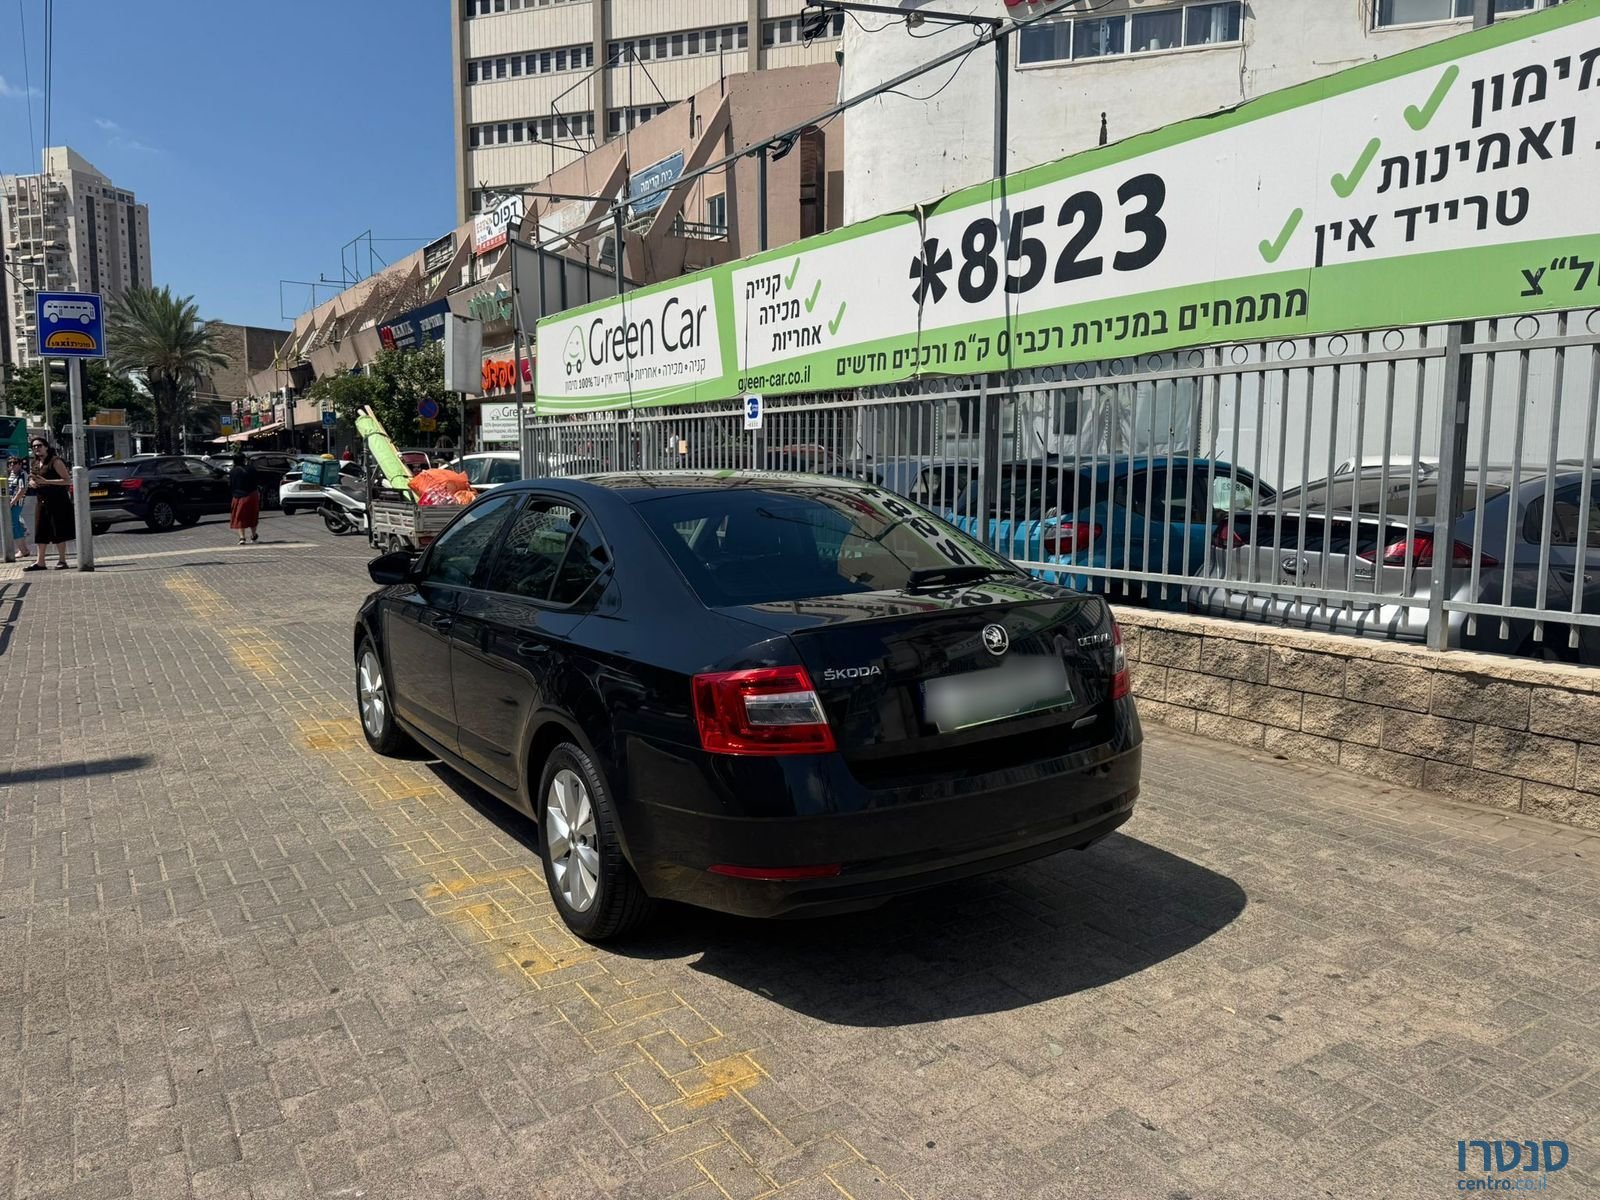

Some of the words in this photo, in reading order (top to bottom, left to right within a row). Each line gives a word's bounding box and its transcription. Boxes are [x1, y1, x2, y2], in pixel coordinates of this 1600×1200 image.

[1472, 47, 1600, 129] מימון
[1377, 116, 1576, 194] ואמינות
[492, 201, 517, 227] דפוס
[1394, 187, 1530, 242] טרייד
[1315, 214, 1378, 268] אין
[746, 273, 781, 300] קנייה
[759, 299, 800, 325] מכירה
[1179, 288, 1308, 331] מתמחים
[589, 317, 654, 366] Green
[661, 297, 707, 352] Car
[771, 324, 822, 352] אחריות
[1016, 326, 1064, 354] רכבי
[1071, 309, 1168, 347] במכירת
[893, 343, 947, 369] ורכבים
[997, 329, 1010, 357] 0
[634, 366, 657, 381] אחריות
[662, 362, 683, 377] מכירה
[689, 358, 706, 375] קניה
[836, 352, 887, 376] חדשים
[824, 665, 882, 681] ŠKODA
